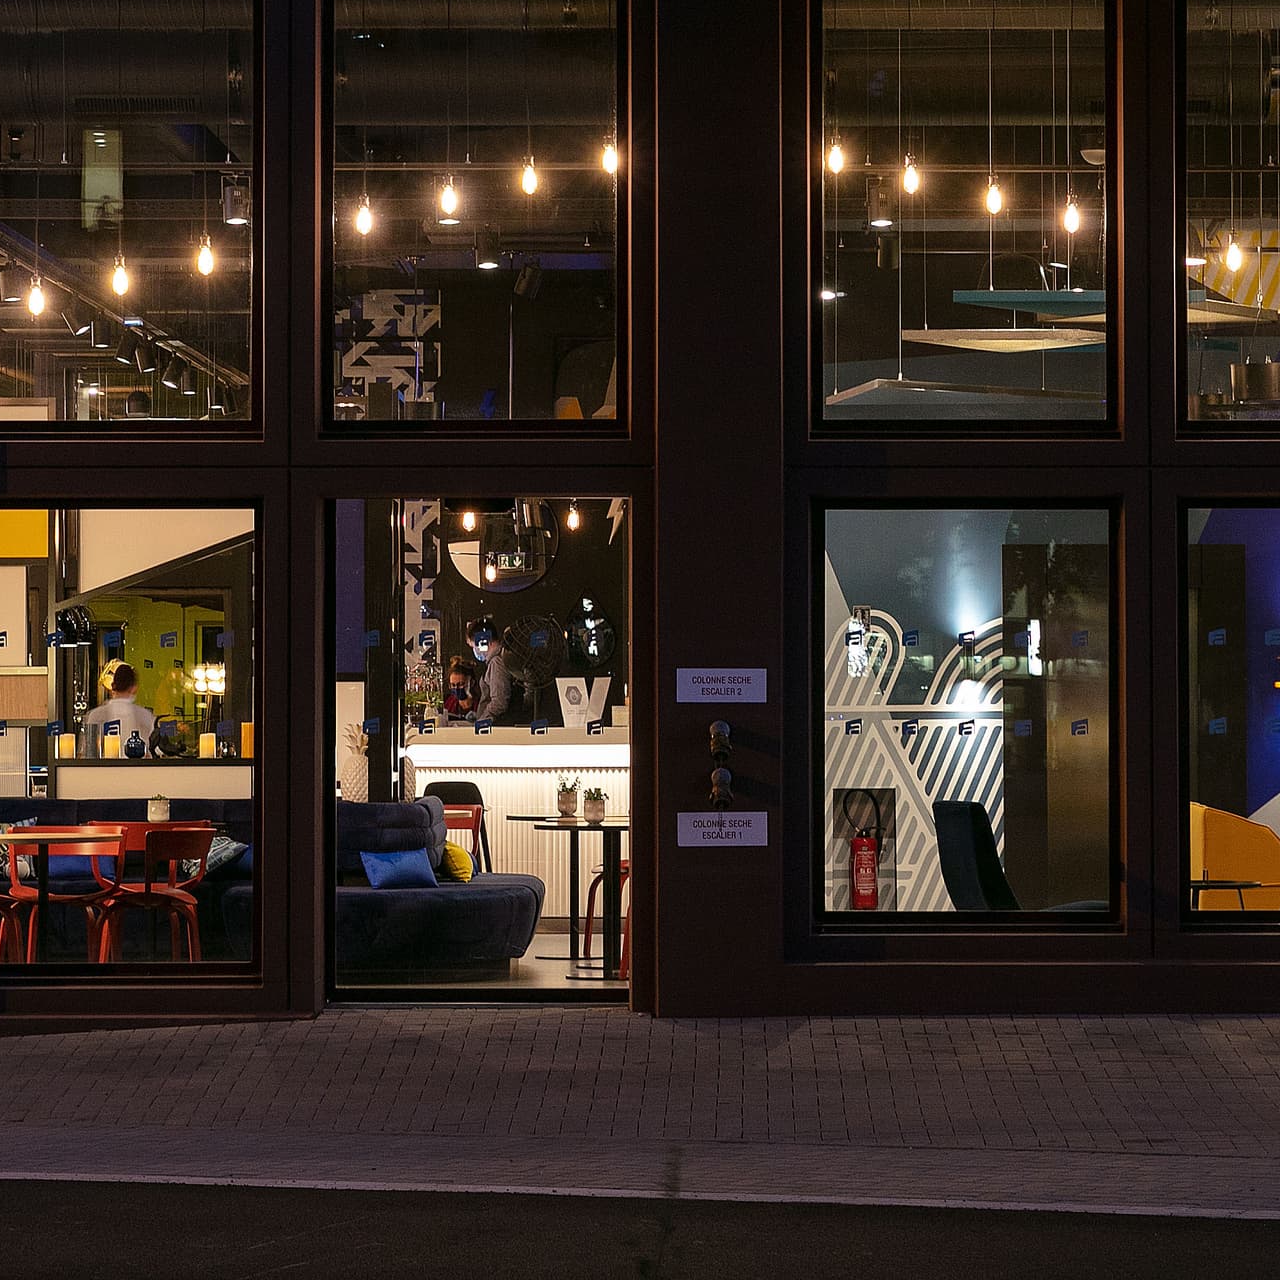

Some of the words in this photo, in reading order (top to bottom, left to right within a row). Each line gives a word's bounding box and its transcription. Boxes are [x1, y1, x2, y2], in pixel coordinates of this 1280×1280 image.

[692, 676, 726, 685] COLONNE
[727, 676, 752, 685] SECHE
[701, 687, 736, 696] ESCALIER
[737, 687, 742, 696] 2
[692, 819, 727, 829] COLONNE
[728, 819, 753, 828] SECHE
[702, 831, 737, 840] ESCALIER
[738, 831, 743, 840] 1
